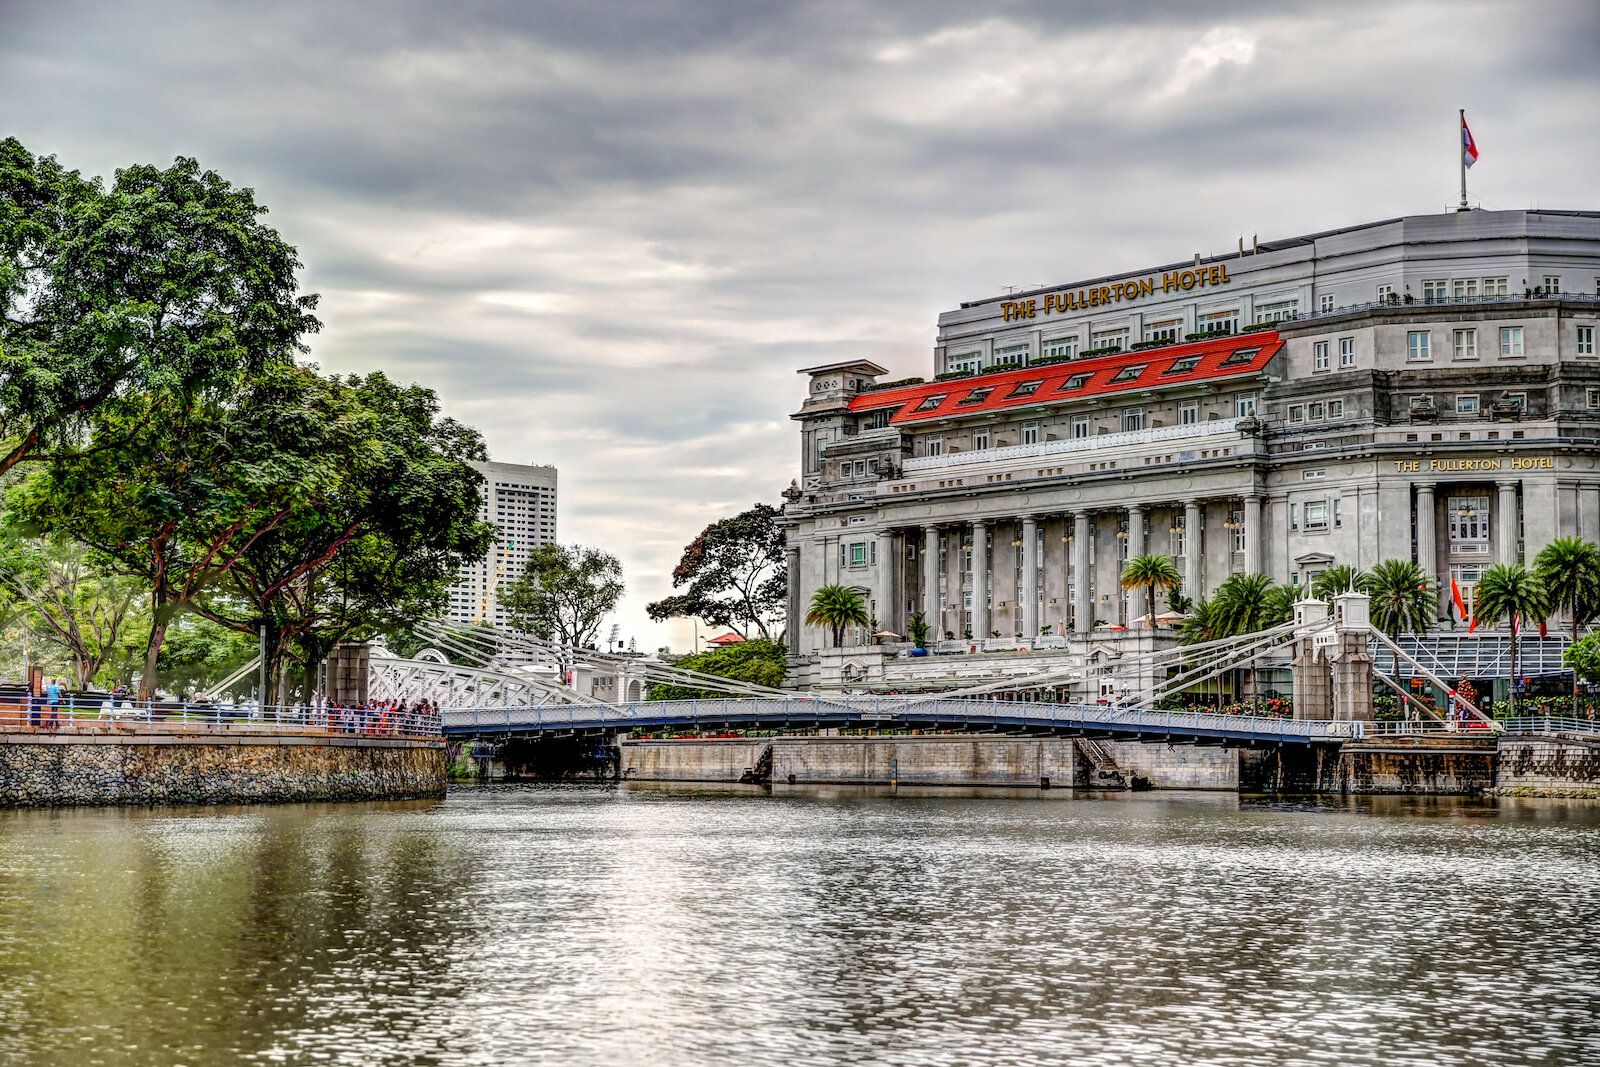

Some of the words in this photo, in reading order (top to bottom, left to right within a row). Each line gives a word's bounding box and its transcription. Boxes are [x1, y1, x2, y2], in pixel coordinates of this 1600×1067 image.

[1001, 301, 1035, 321] THE
[1044, 278, 1153, 314] FULLERTON
[1163, 264, 1230, 293] HOTEL
[1394, 460, 1419, 472] THE
[1430, 459, 1501, 471] FULLERTON
[1511, 457, 1553, 469] HOTEL
